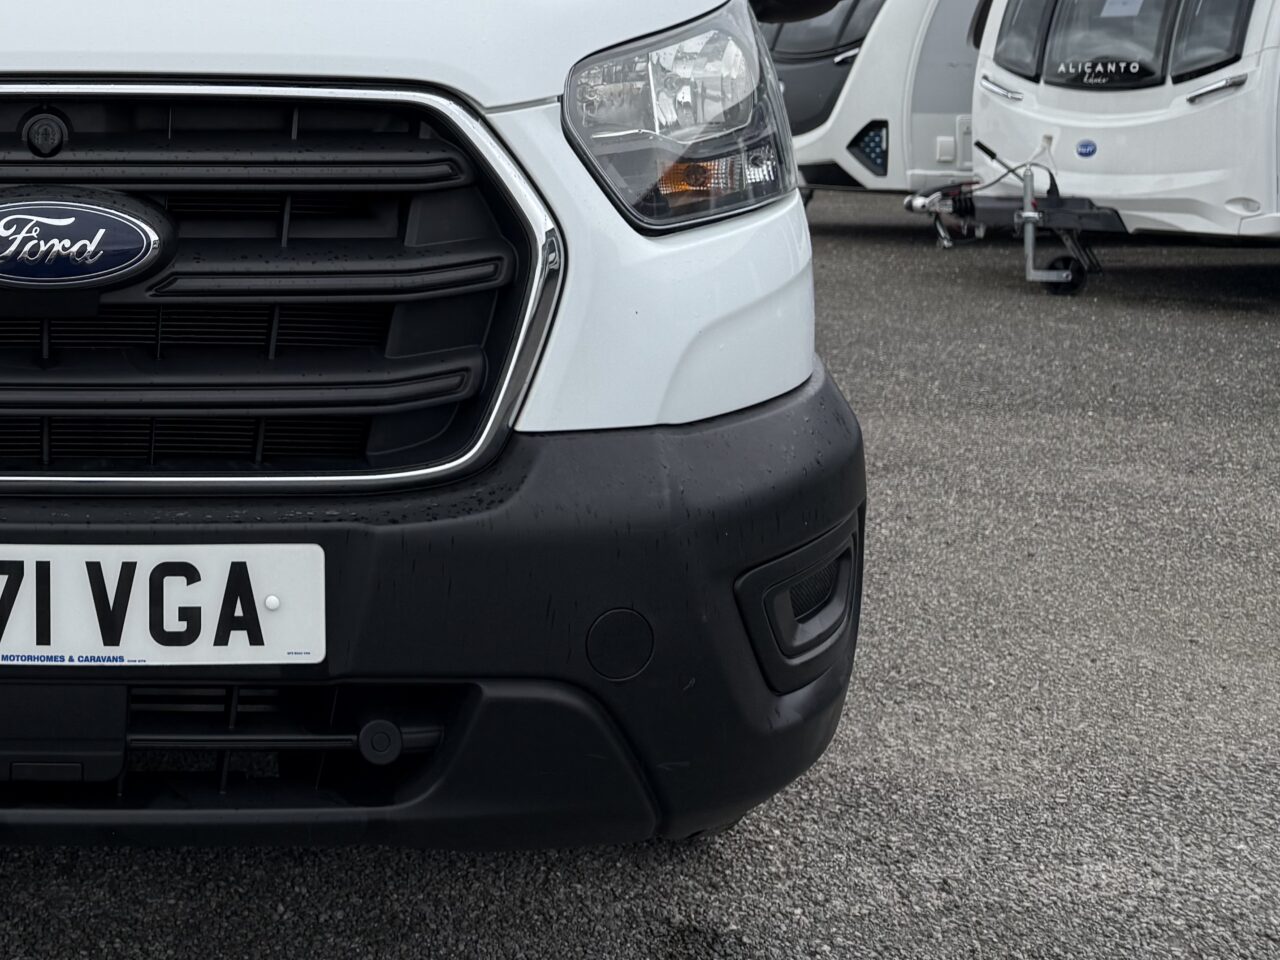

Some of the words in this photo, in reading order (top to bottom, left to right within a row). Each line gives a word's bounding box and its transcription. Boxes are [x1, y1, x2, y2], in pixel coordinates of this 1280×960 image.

[1057, 62, 1139, 74] ALICANTO
[85, 561, 265, 647] VGA
[1, 654, 65, 663] MOTORHOMES
[68, 655, 75, 663] &
[77, 655, 125, 663] CARAVANS
